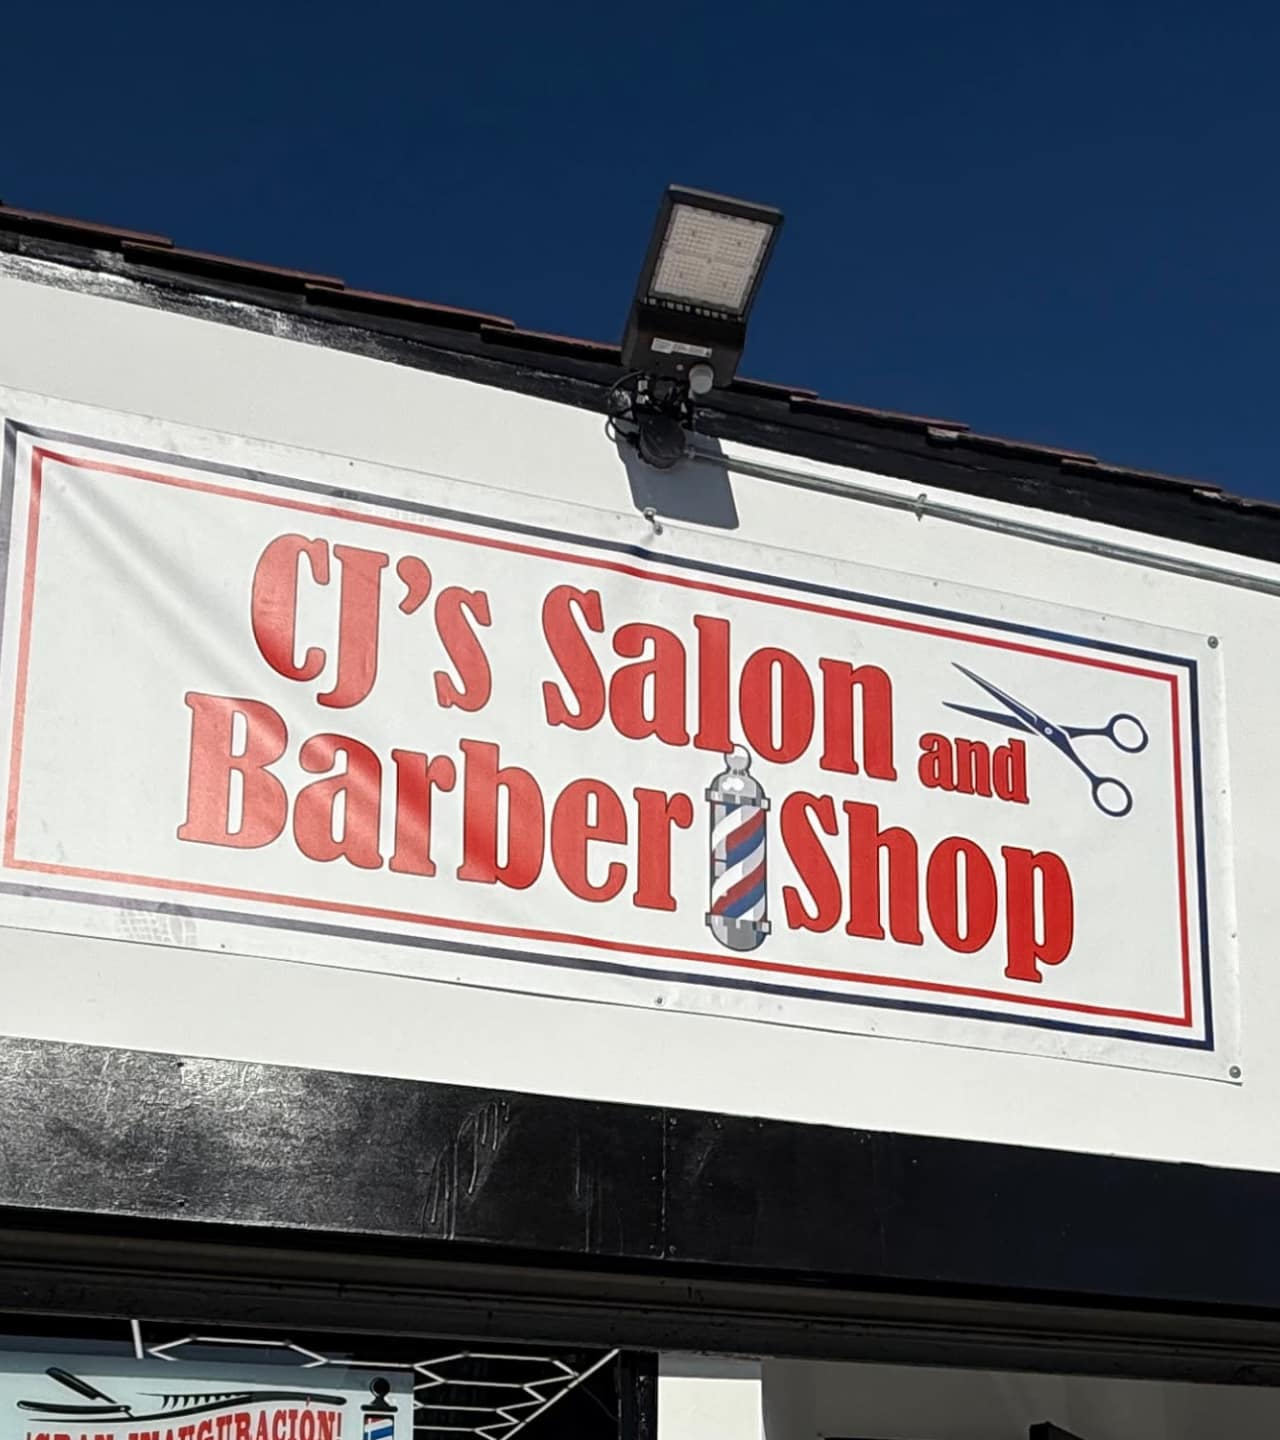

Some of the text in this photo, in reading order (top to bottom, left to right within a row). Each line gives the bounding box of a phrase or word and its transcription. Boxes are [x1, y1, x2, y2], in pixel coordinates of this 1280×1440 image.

[251, 533, 1030, 804] CJ's Salon and
[176, 691, 1075, 983] Barber Shop
